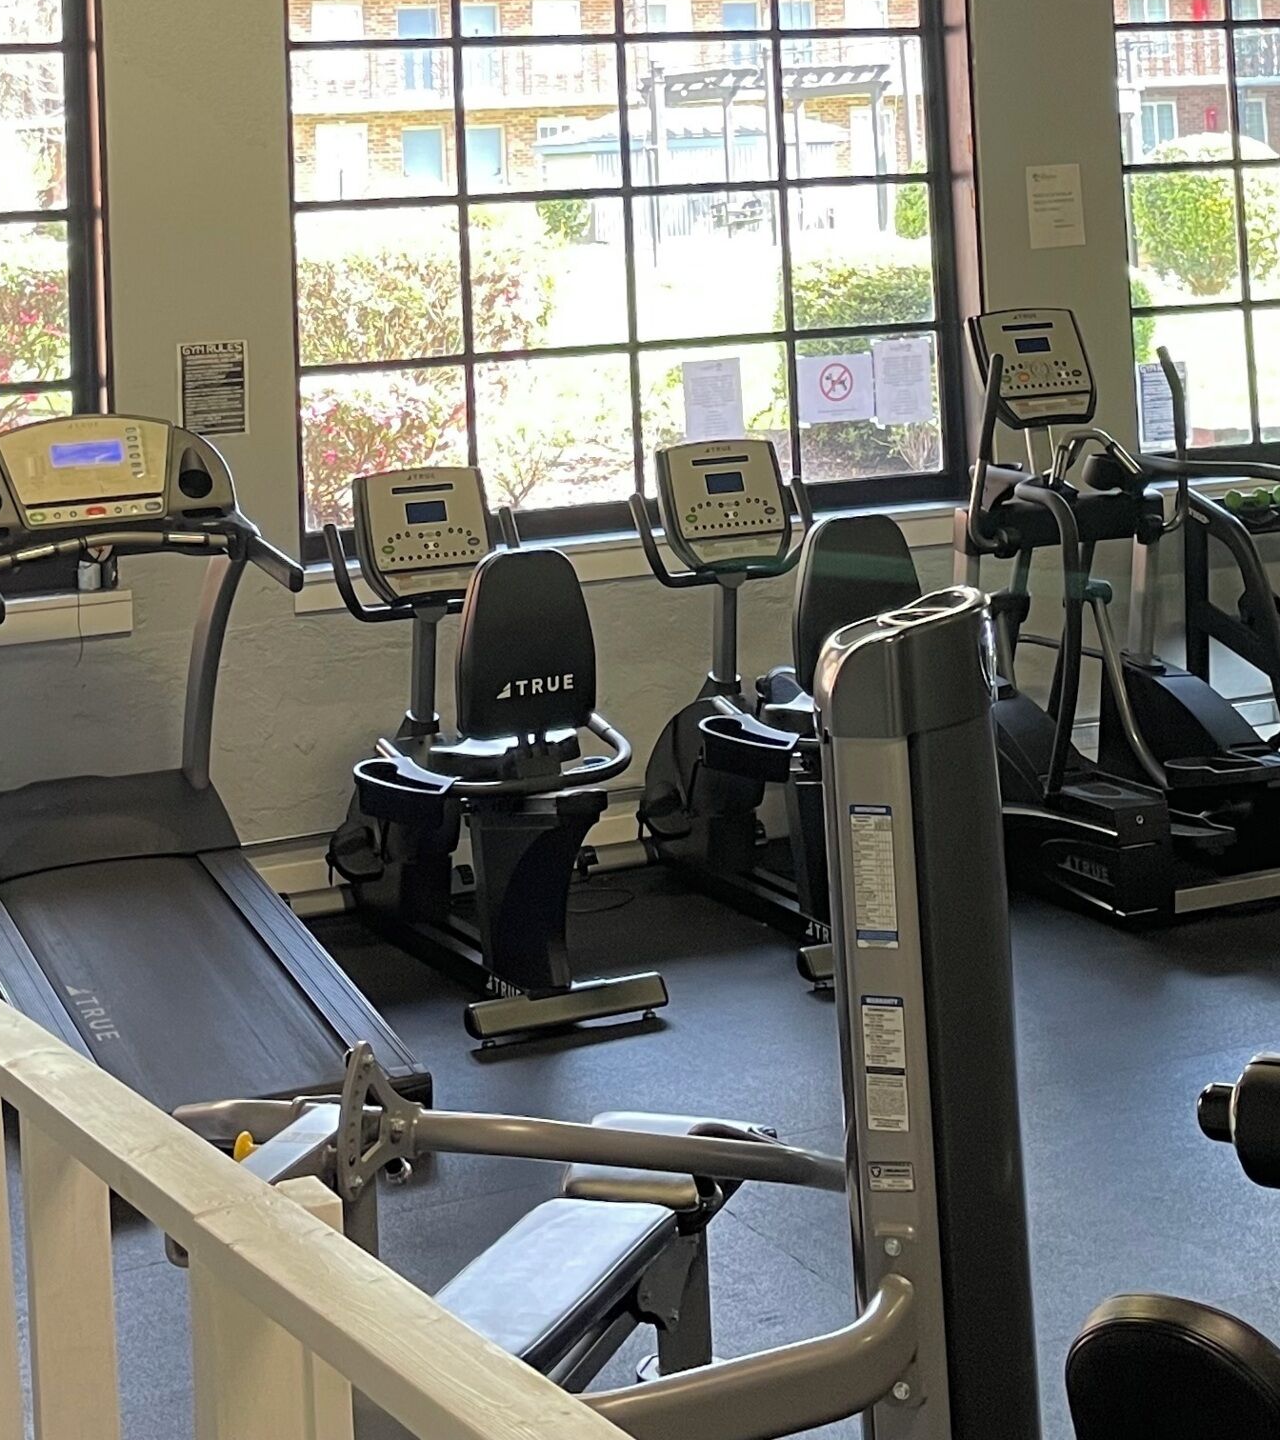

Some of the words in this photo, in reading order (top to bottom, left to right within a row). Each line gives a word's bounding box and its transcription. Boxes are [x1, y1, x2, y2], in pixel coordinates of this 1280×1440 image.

[182, 345, 205, 356] GYM
[206, 343, 243, 354] RULES
[515, 673, 574, 696] TRUE
[75, 996, 120, 1041] TRUE
